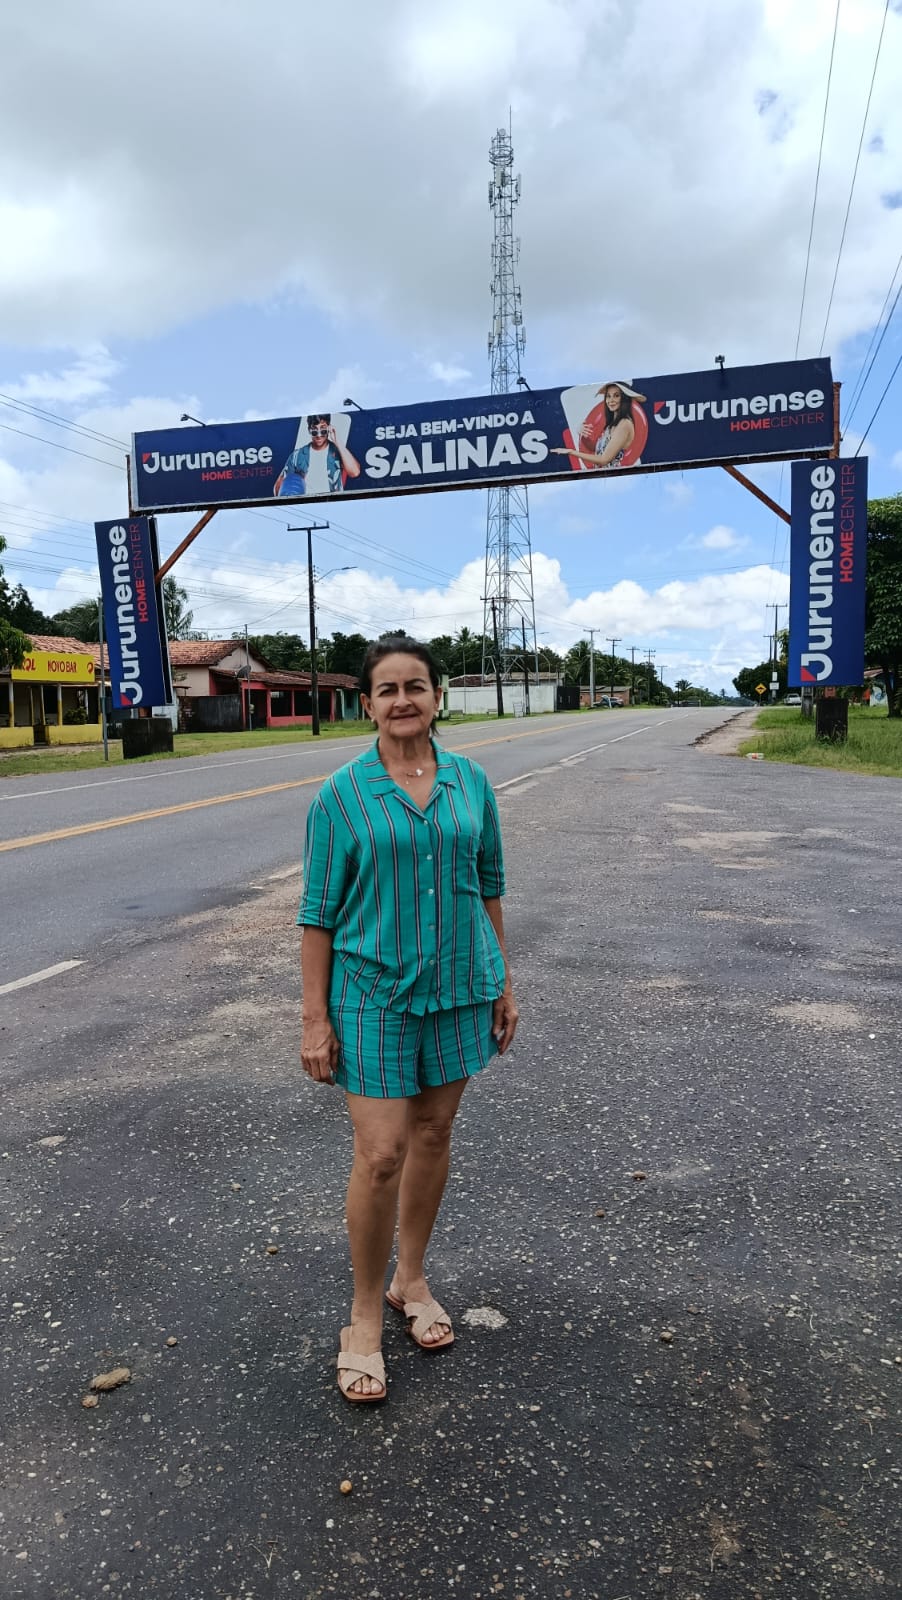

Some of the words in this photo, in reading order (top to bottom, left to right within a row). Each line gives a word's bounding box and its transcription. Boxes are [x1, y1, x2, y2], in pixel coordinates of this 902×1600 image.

[375, 423, 417, 440] SEJA
[421, 411, 519, 436] BEM-VINDO
[521, 410, 535, 425] A
[653, 389, 825, 426] Jurunense
[142, 446, 273, 474] Jurunense
[365, 429, 549, 479] SALINAS
[800, 465, 836, 681] Jurunense
[109, 525, 143, 706] Jurunense
